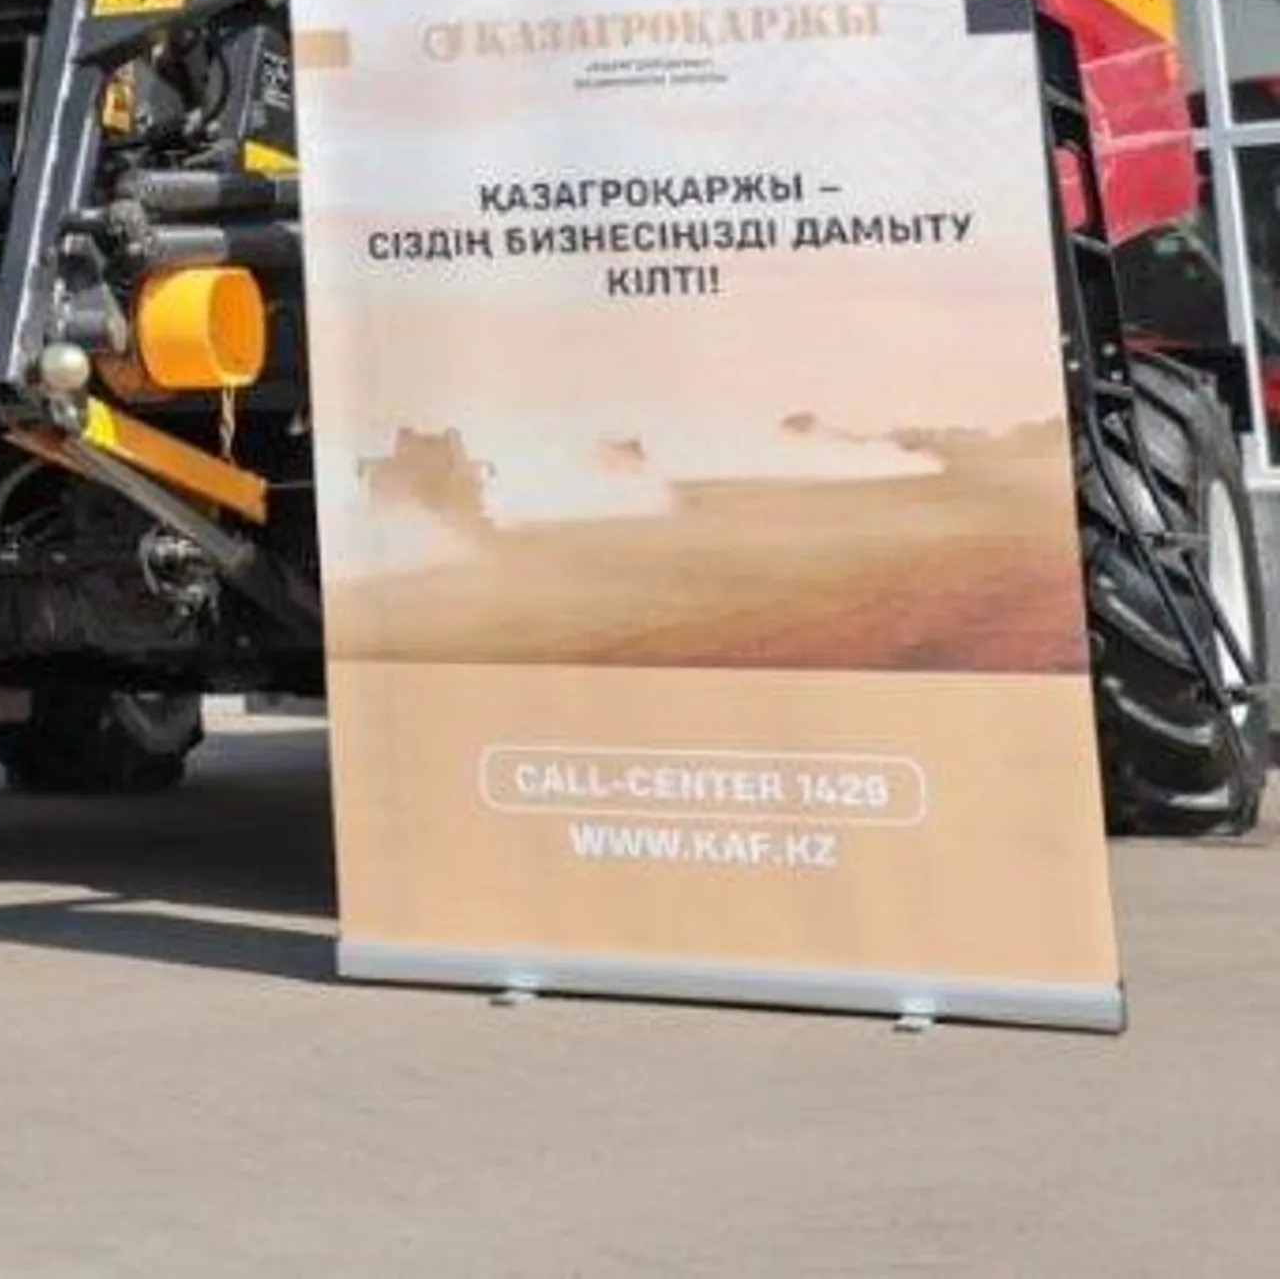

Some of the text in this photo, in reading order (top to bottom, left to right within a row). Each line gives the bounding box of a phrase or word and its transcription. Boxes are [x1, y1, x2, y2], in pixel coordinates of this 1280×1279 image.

[480, 175, 803, 212] ҚАЗАГРОҚАРЖЫ
[368, 213, 974, 260] СІЗДІҢ БИЗНЕСІҢІЗДІ ДАМЫТУ
[607, 264, 721, 297] КІЛТІ!
[514, 762, 889, 807] CALL-CENTER 1429
[568, 823, 837, 866] WWW.KAF.KZ
